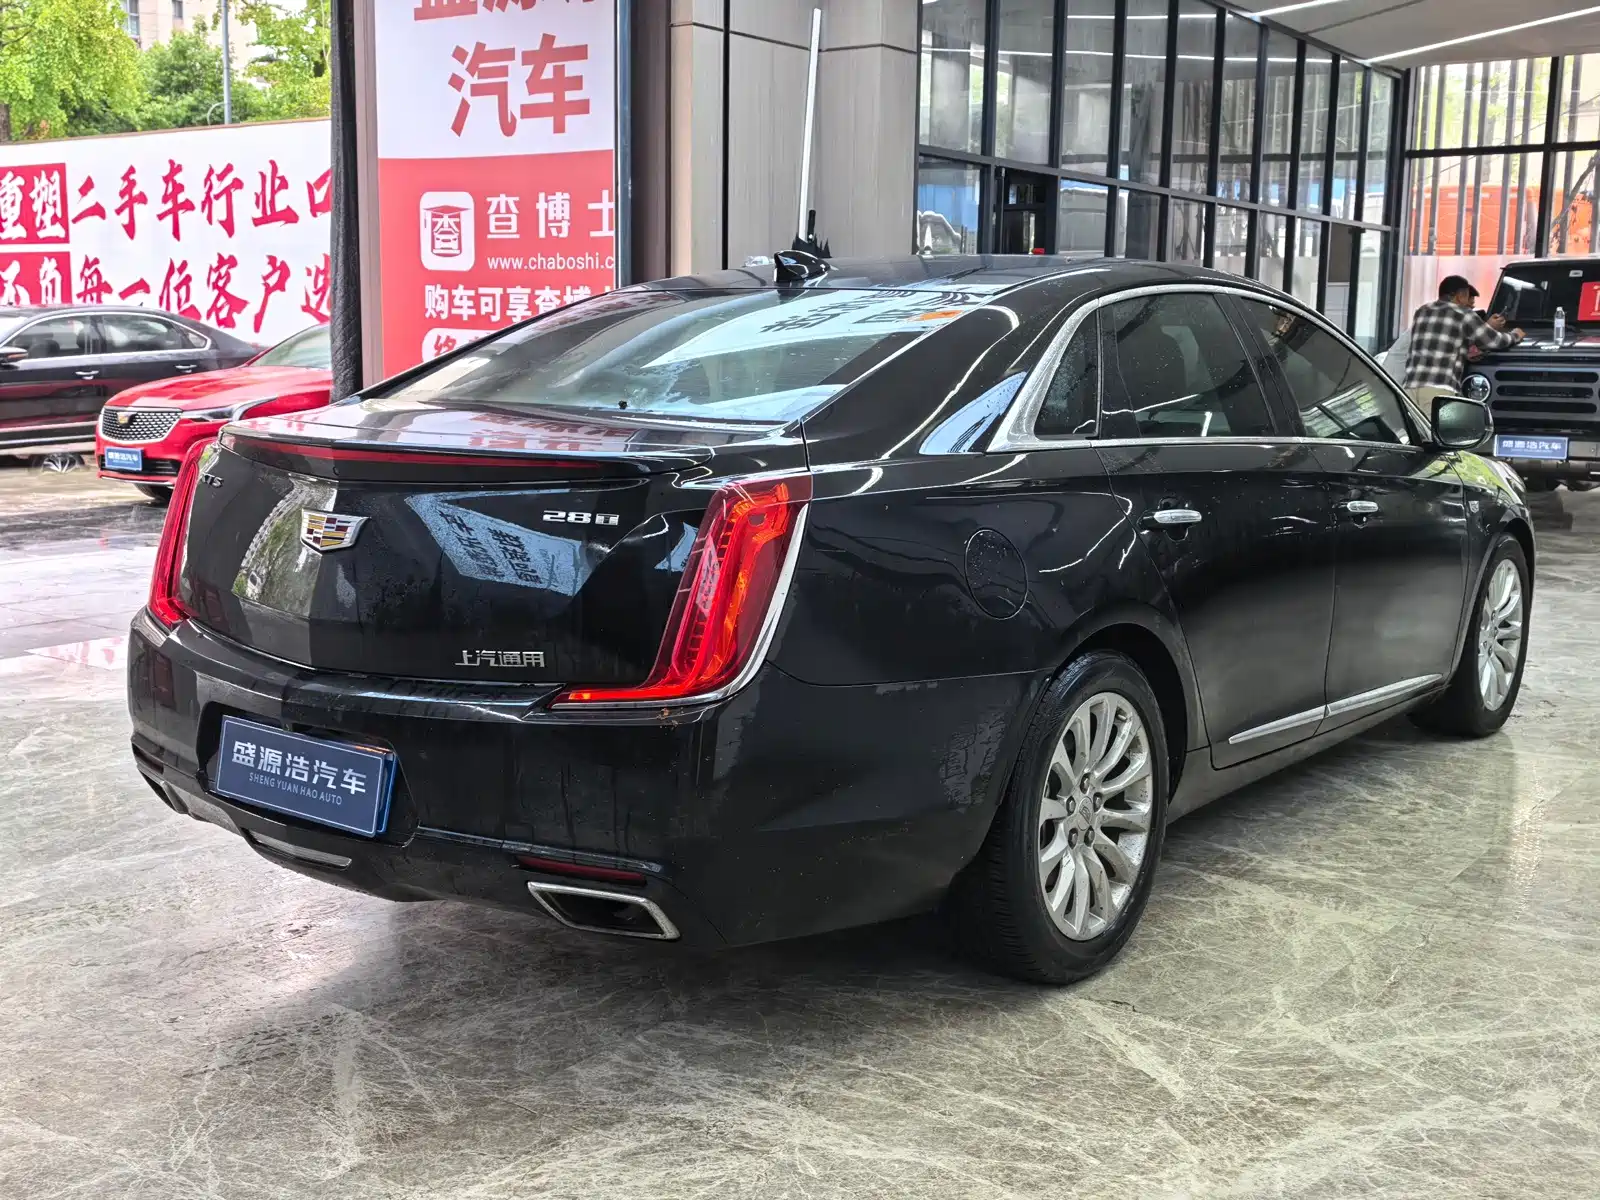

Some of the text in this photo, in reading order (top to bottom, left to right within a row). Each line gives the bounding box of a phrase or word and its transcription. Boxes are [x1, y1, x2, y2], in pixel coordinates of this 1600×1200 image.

[448, 33, 591, 138] 汽车
[486, 189, 614, 239] 查博士
[454, 649, 545, 668] 上汽通用
[231, 740, 367, 795] 盛源浩汽车
[248, 772, 343, 806] SHENG YUAN HAO AUTO
